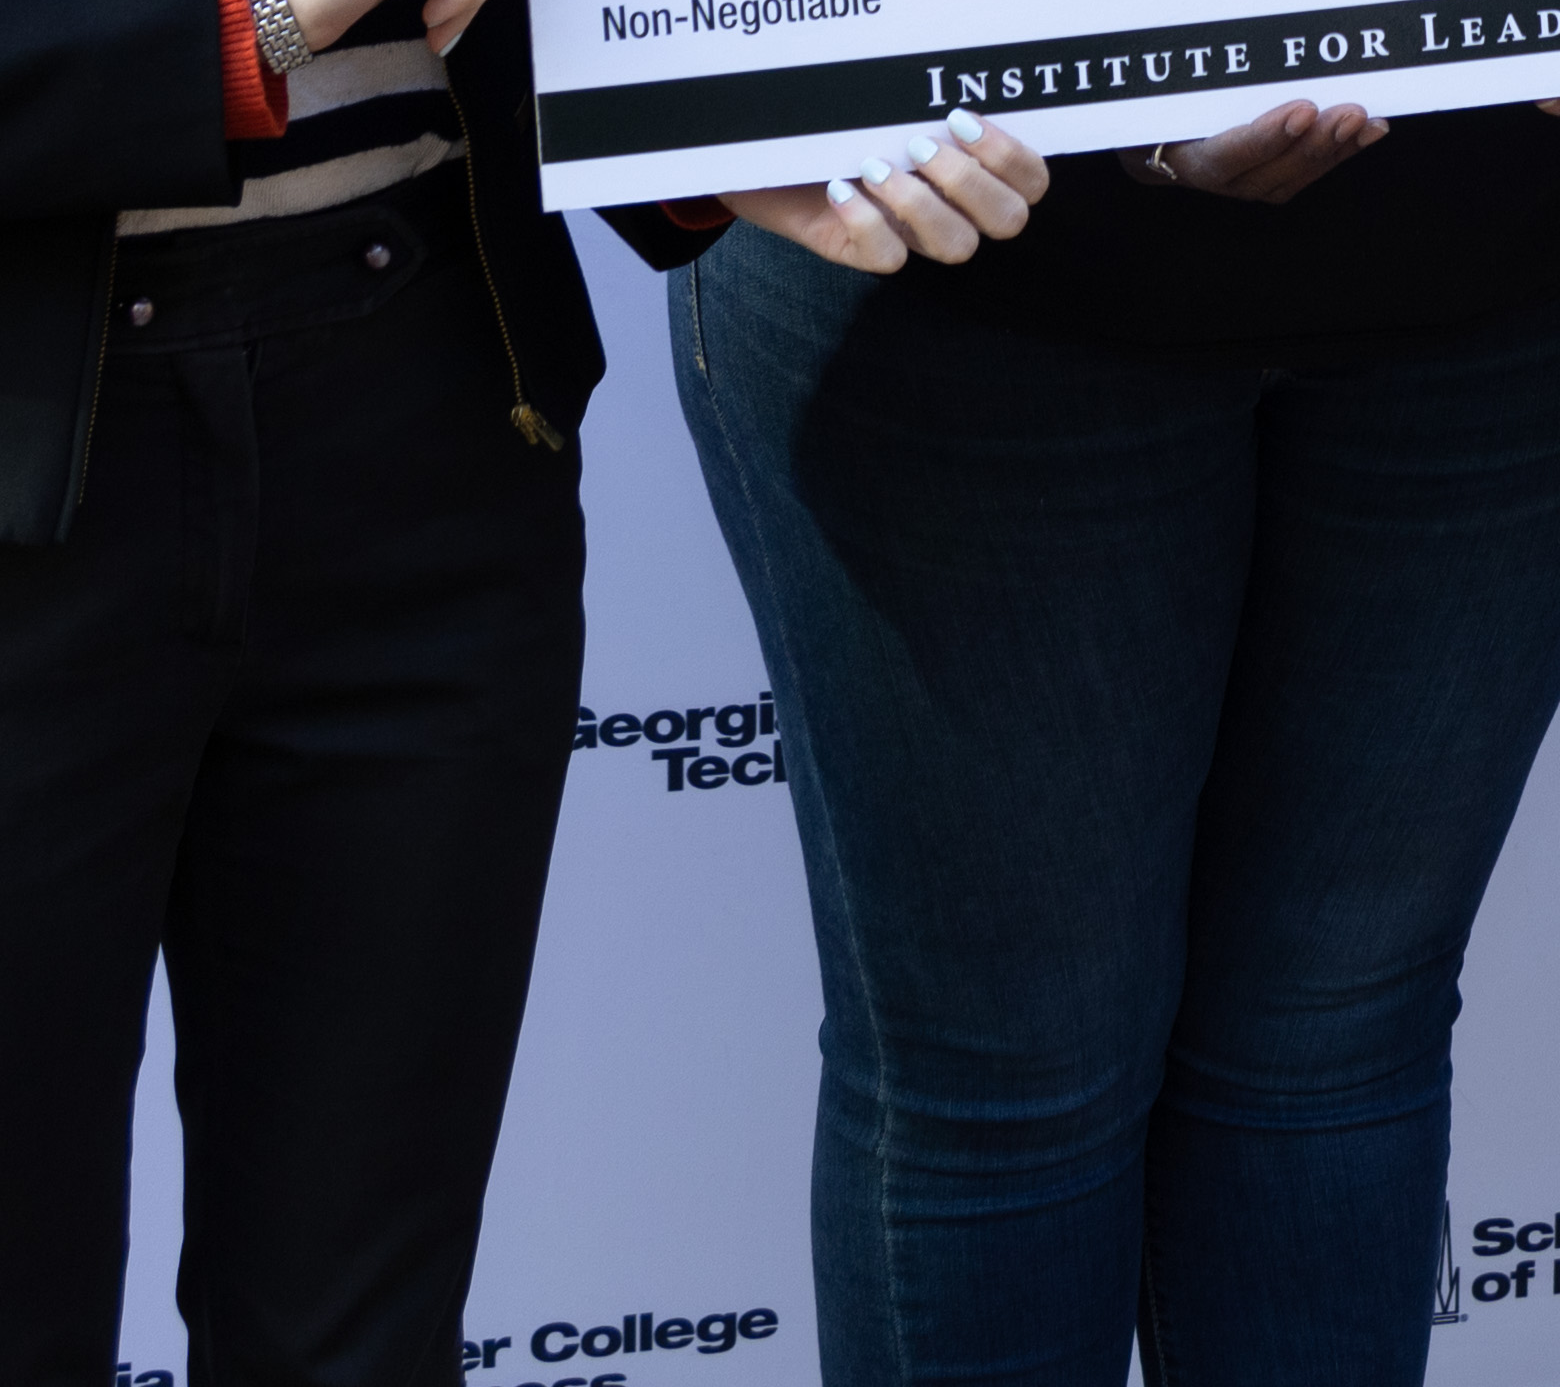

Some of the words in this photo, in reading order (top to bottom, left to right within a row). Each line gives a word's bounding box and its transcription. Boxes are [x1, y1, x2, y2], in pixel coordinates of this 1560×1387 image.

[927, 44, 1249, 106] INSTITUTE
[1284, 29, 1389, 66] FOR
[571, 690, 781, 751] eorgi
[1472, 1261, 1535, 1302] of
[531, 1309, 778, 1362] College
